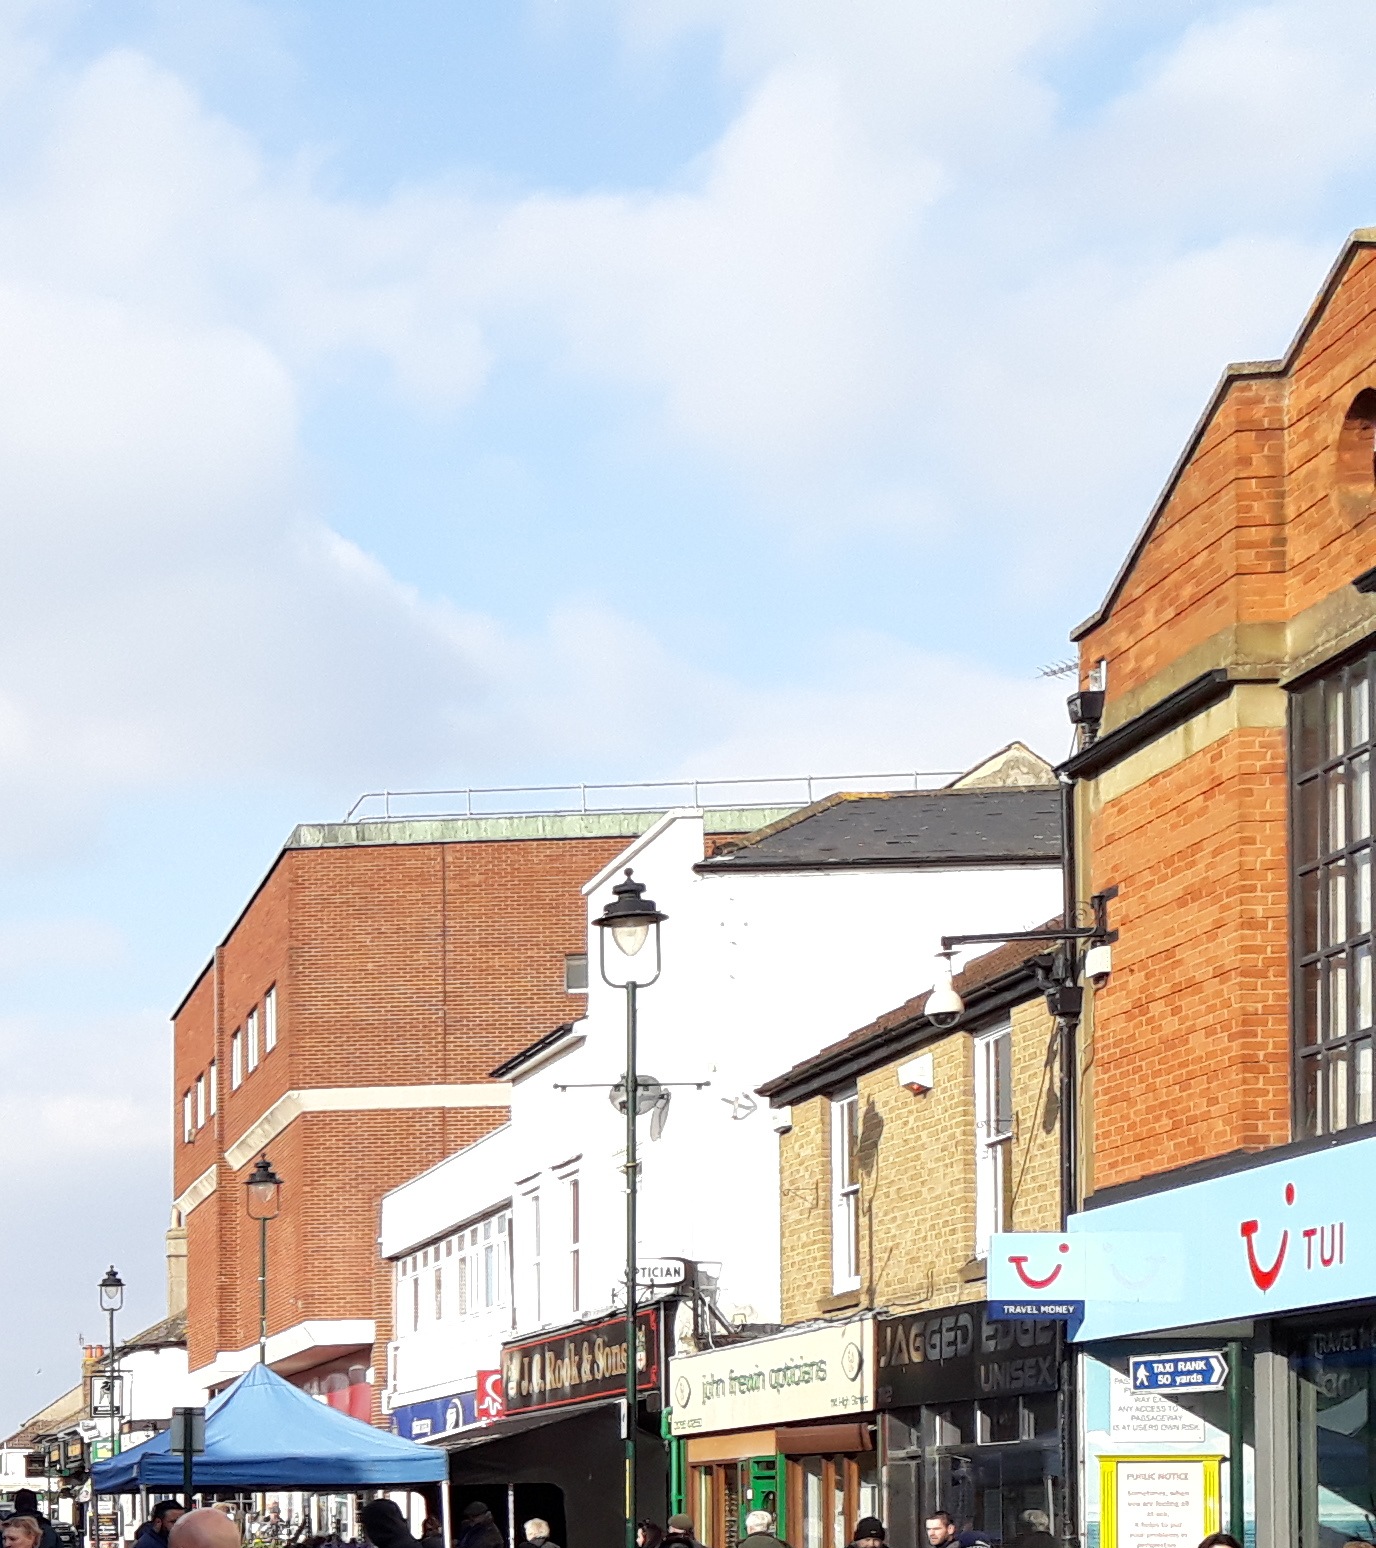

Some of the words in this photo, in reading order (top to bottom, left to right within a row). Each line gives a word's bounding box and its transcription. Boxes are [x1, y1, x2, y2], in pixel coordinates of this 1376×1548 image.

[1302, 1221, 1344, 1270] TUI
[1003, 1305, 1039, 1314] TRAVEL
[1040, 1304, 1075, 1314] MONEY
[879, 1312, 974, 1368] JAGGED
[546, 1342, 580, 1390] Rook
[581, 1341, 593, 1383] &
[594, 1337, 627, 1380] Sons
[702, 1373, 725, 1405] john
[768, 1355, 827, 1395] opticians
[980, 1356, 1053, 1392] UNISEX
[1152, 1362, 1174, 1374] TAXI
[1177, 1360, 1208, 1372] RANK
[1157, 1374, 1171, 1385] 50
[1175, 1373, 1203, 1386] yards
[1126, 1472, 1156, 1481] PUBLIC
[1157, 1472, 1189, 1481] NOTICE
